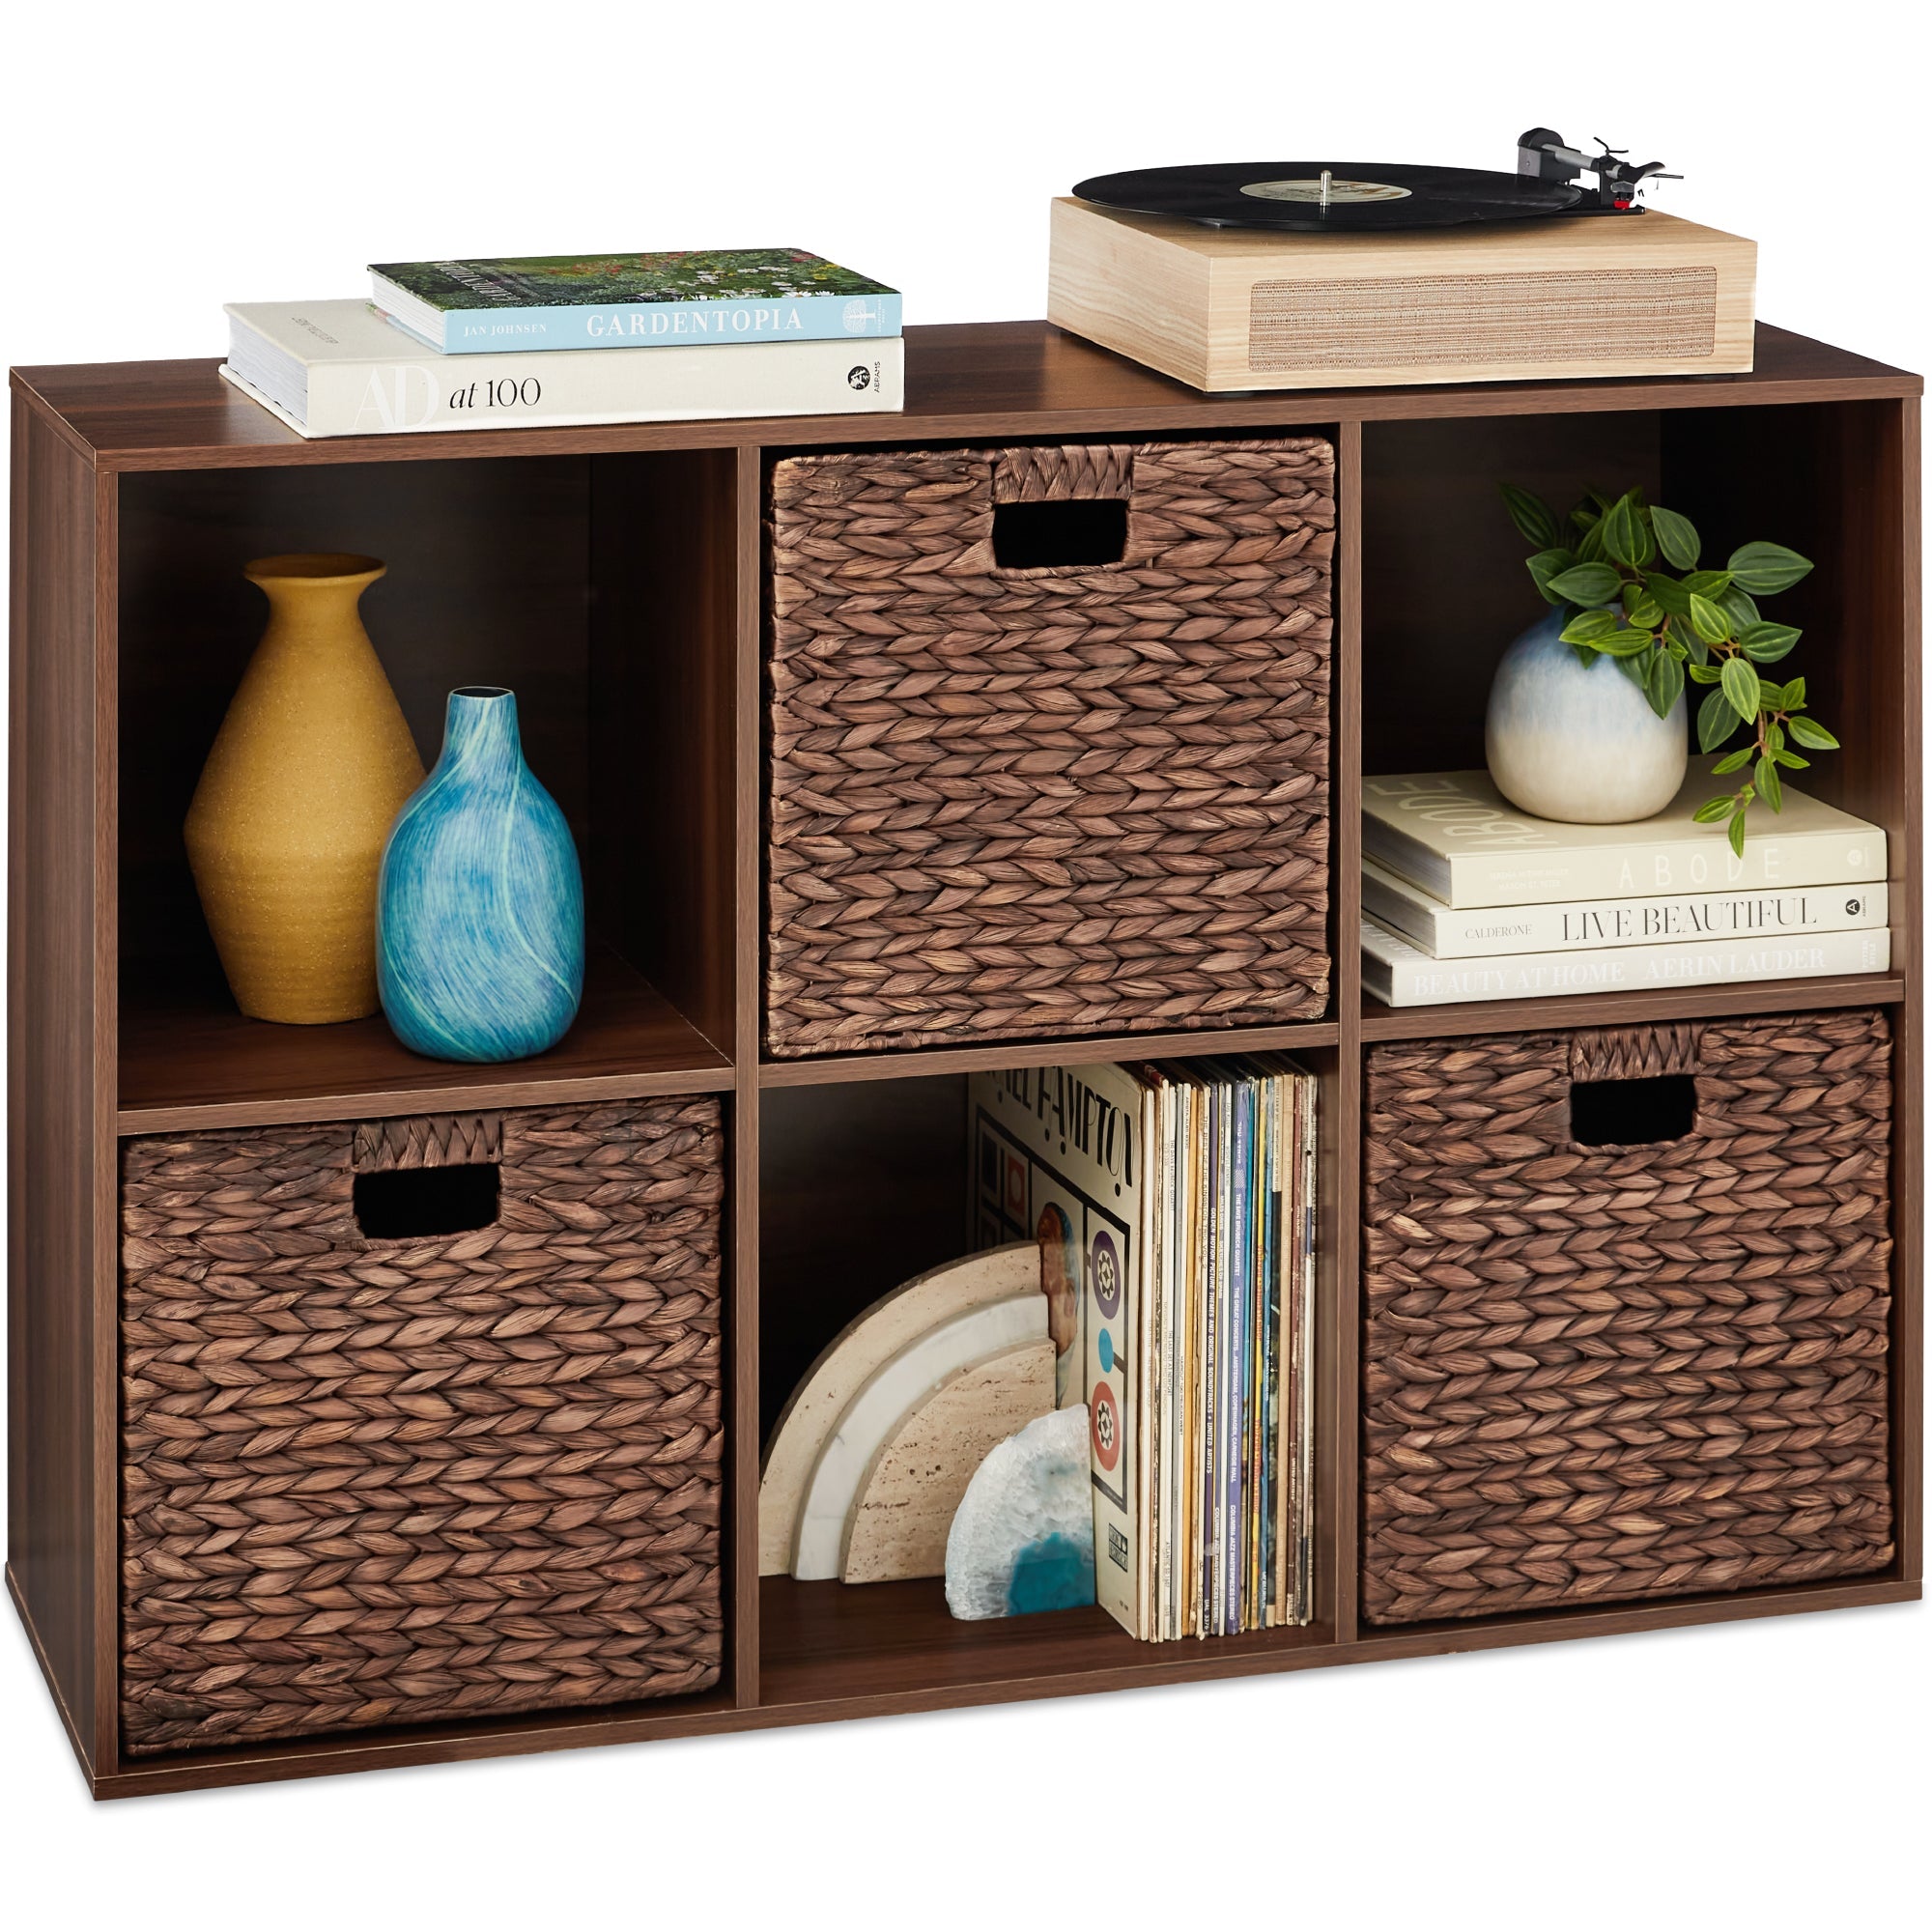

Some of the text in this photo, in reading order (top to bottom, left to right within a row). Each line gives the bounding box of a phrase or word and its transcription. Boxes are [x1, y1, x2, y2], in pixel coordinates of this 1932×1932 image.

[464, 324, 548, 337] JAN JOHNSEN
[586, 307, 804, 337] GARDENTOPIA
[348, 365, 541, 432] AD at 100
[1366, 780, 1560, 845] ABODE
[1619, 848, 1780, 890] ABODE
[1464, 923, 1533, 940] CALDERONE
[1562, 897, 1817, 944] LIVE BEAUTIFUL
[1413, 948, 1827, 998] BEAUTY AT HOME AERIN LAUDER
